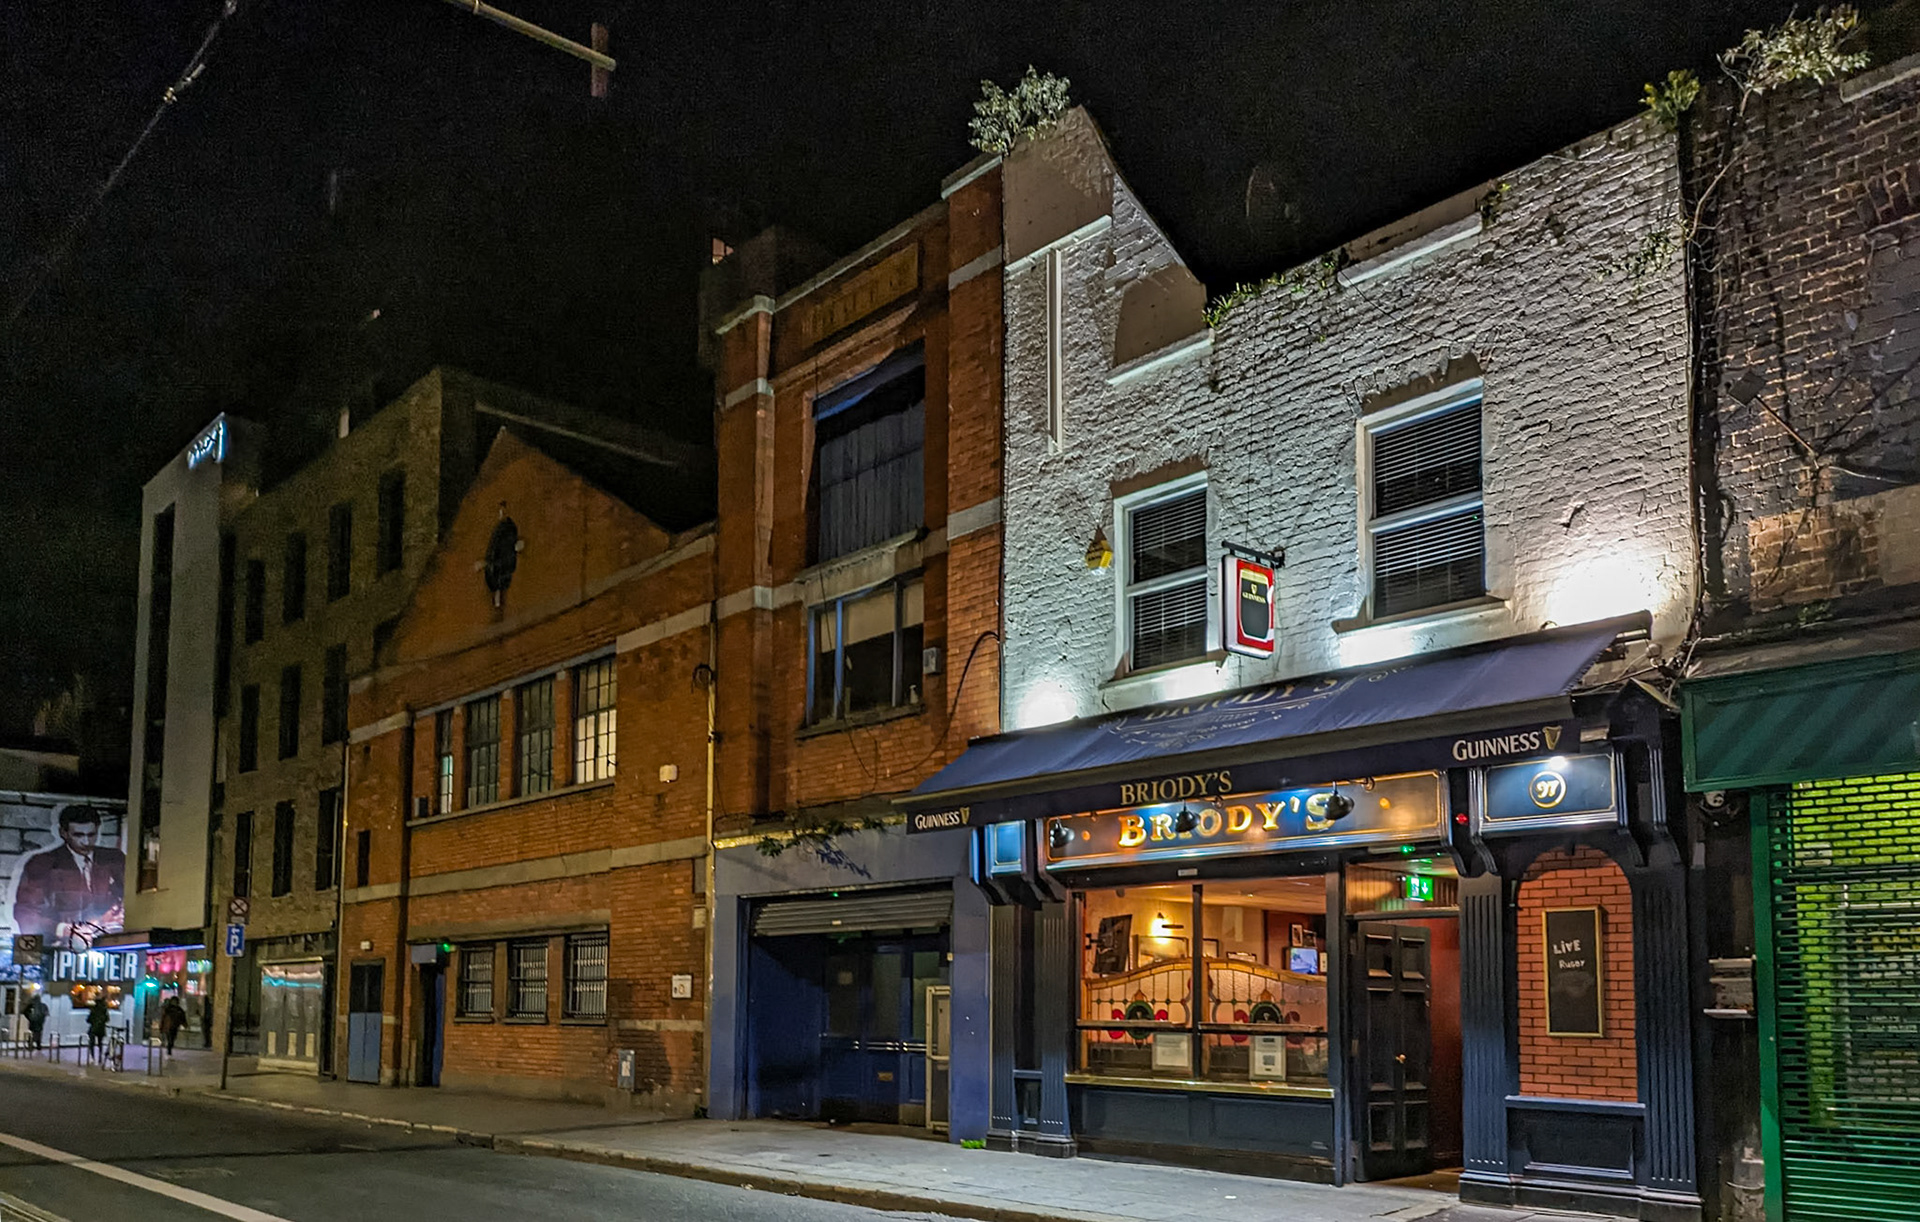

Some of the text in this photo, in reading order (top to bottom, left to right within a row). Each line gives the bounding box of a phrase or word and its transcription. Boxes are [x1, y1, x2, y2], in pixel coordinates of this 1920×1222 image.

[1452, 731, 1541, 761] GUINNESS
[1120, 770, 1232, 806] BRIODY'S
[1536, 780, 1560, 799] 97
[914, 811, 960, 830] GUINNESS
[1118, 792, 1337, 848] BRODY'S
[230, 935, 239, 953] P
[58, 951, 138, 979] PIPER
